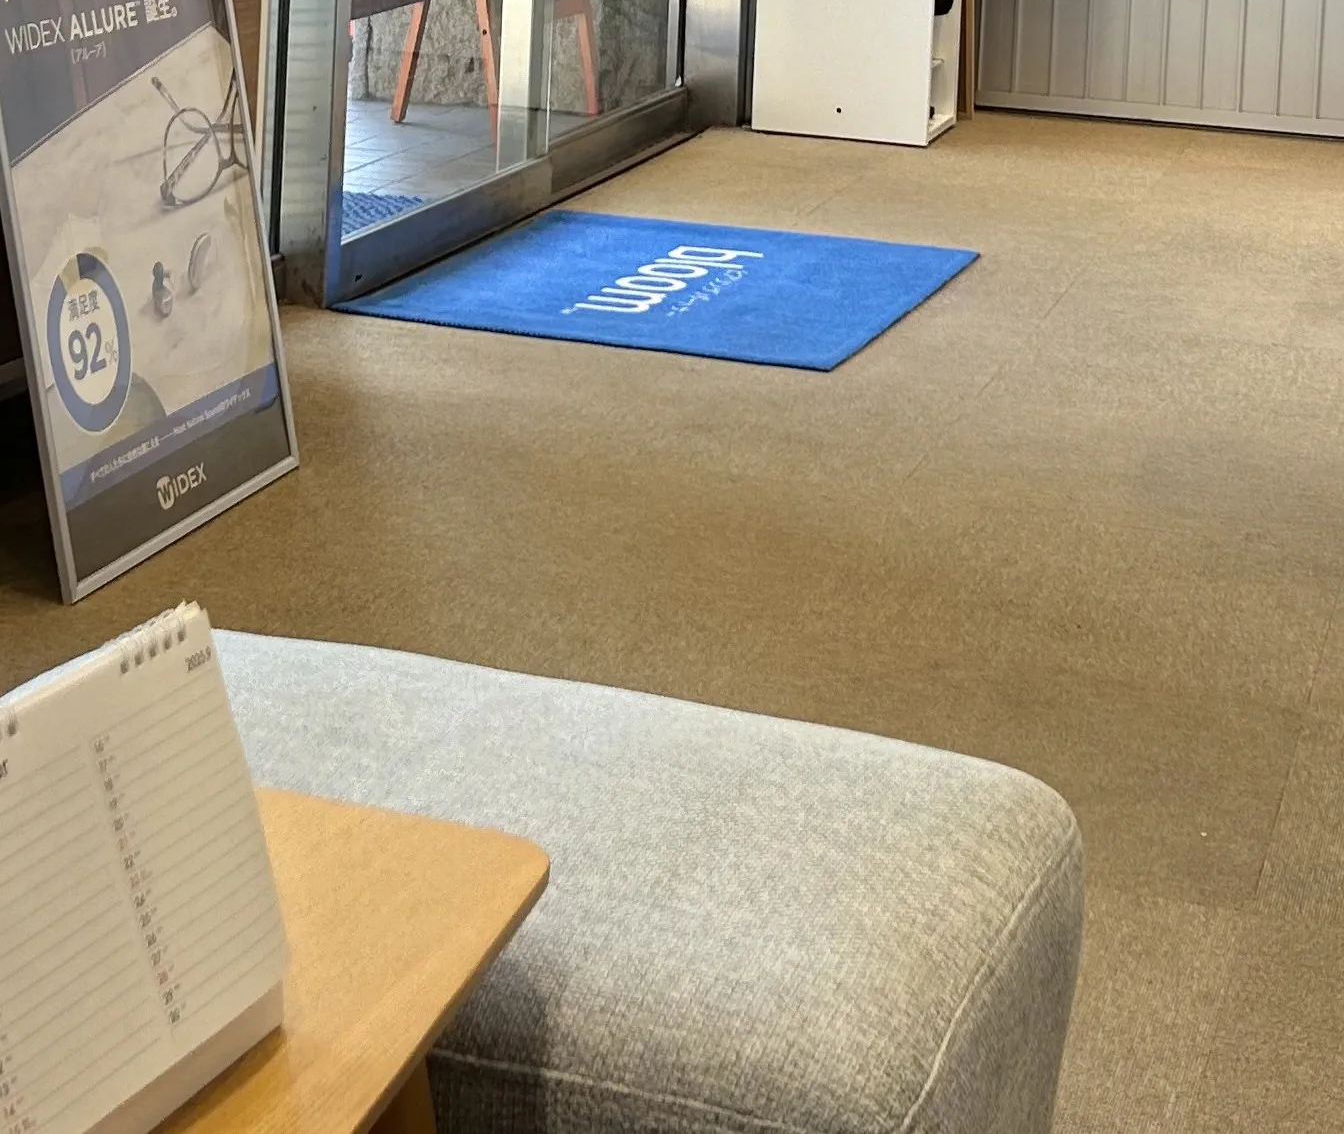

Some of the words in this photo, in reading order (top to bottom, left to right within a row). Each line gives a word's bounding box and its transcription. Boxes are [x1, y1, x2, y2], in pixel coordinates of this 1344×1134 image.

[5, 16, 65, 55] WIDEX
[69, 1, 138, 42] ALLURE
[574, 245, 764, 313] bloom
[67, 290, 101, 322] 満足度
[156, 462, 208, 511] WIDEX
